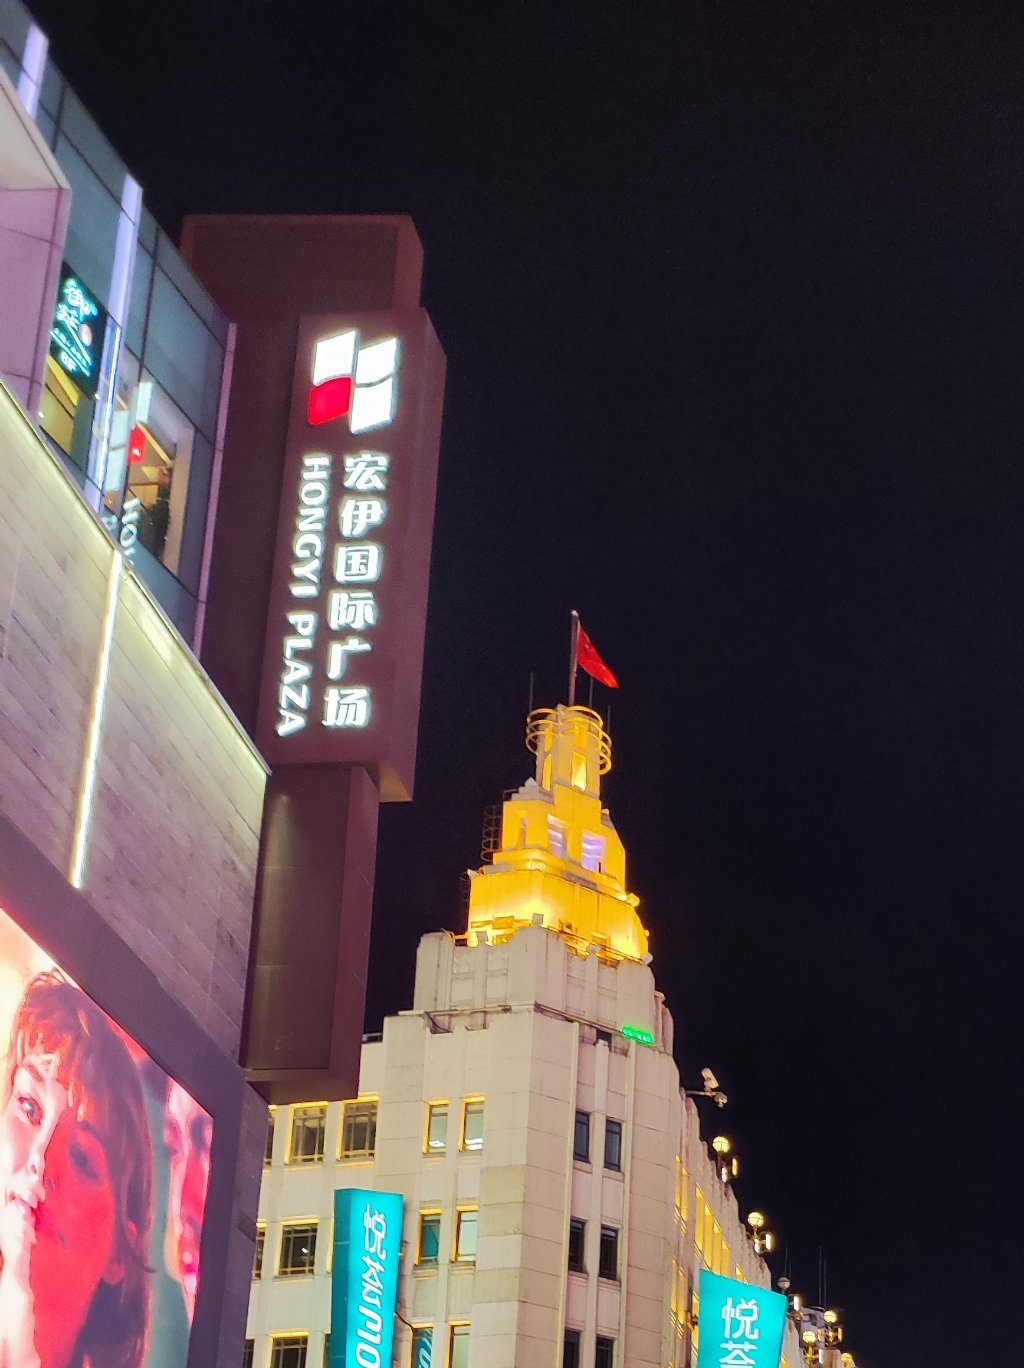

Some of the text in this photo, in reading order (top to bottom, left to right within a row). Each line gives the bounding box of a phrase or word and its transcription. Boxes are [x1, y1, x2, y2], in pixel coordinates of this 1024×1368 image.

[276, 455, 332, 737] HONGYI PLAZA
[322, 452, 391, 728] 宏伊国际广场
